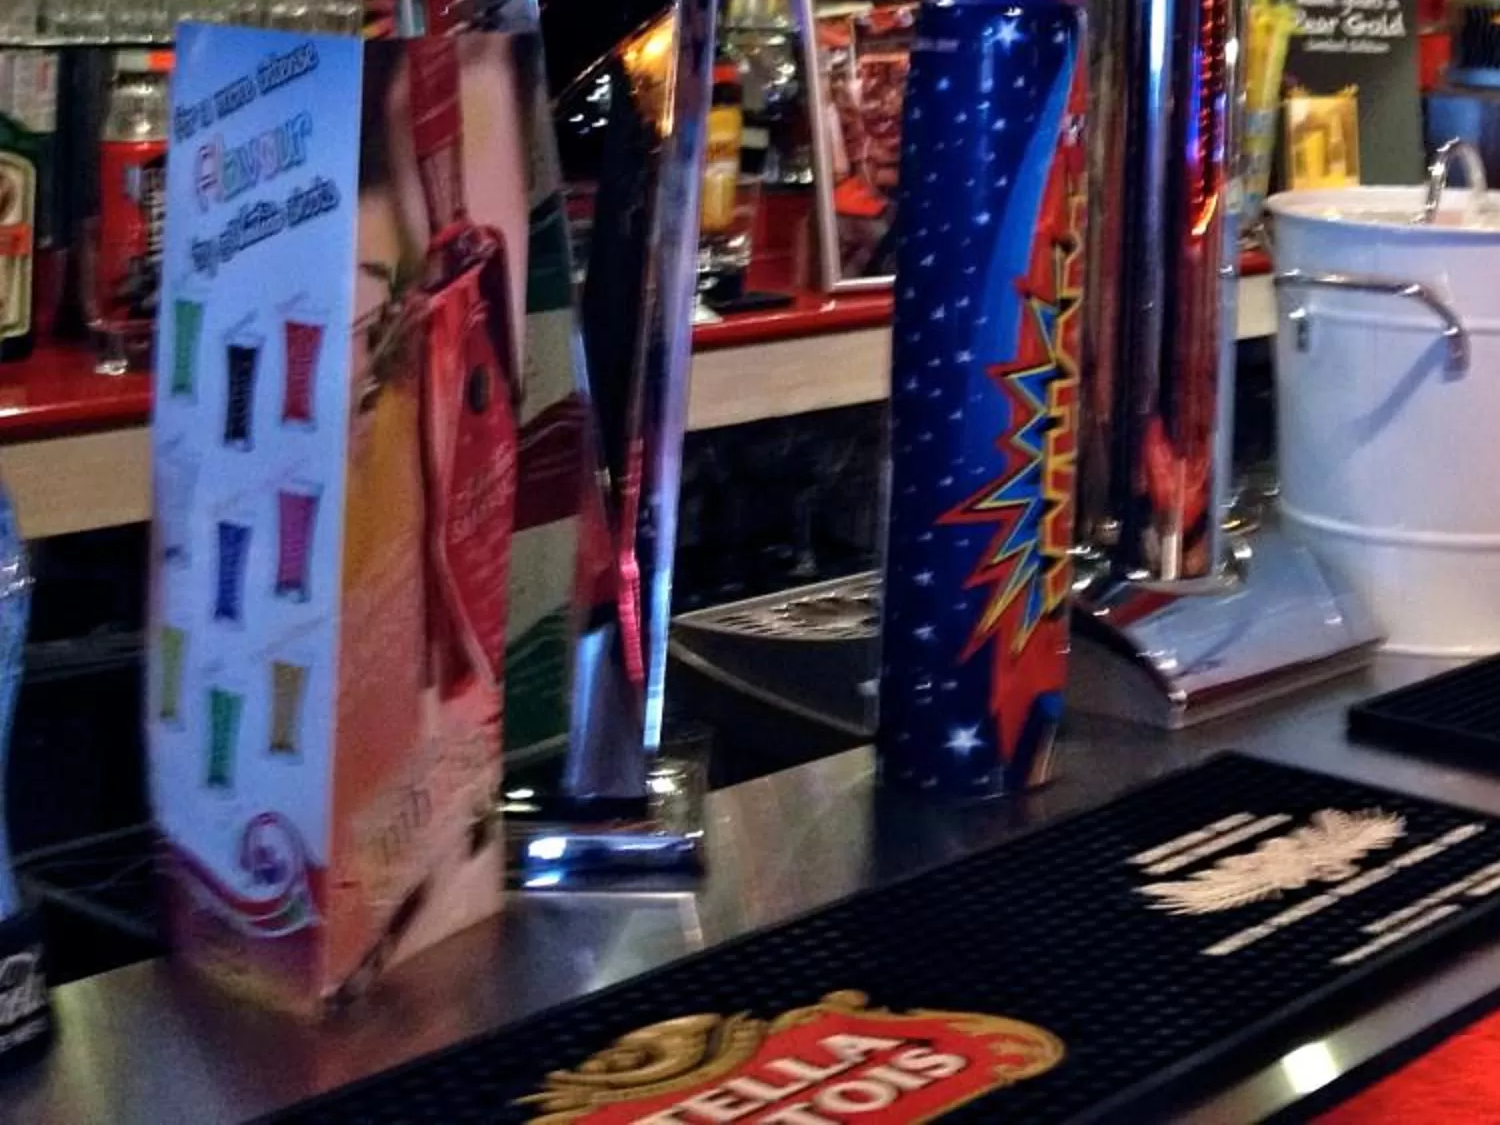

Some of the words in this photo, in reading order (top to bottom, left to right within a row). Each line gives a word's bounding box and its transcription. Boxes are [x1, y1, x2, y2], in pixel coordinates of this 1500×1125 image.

[1341, 10, 1407, 38] Gold
[628, 1032, 906, 1125] TELLA
[752, 1046, 968, 1125] TOIS
